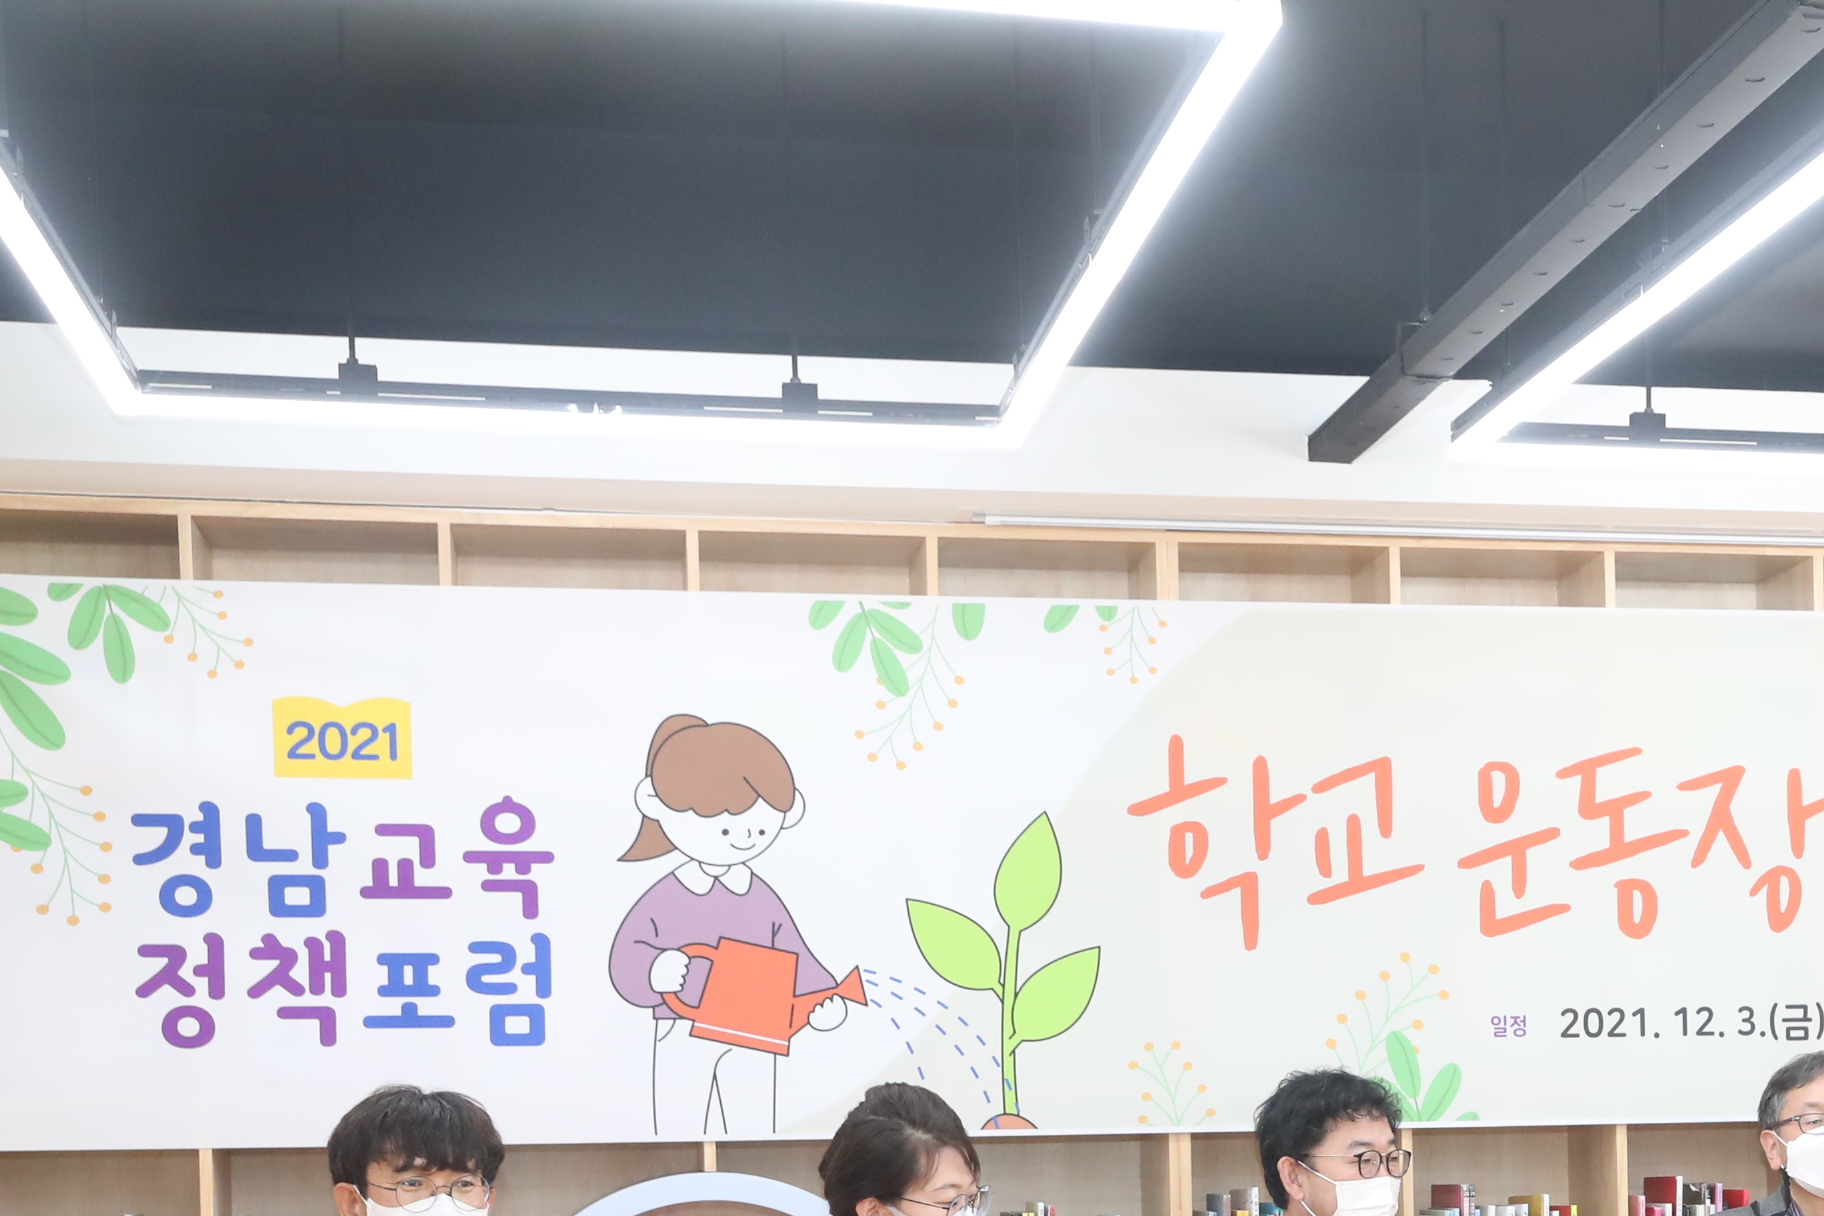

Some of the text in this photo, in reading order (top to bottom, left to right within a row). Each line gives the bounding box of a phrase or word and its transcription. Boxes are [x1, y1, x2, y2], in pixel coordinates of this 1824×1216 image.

[287, 721, 399, 762] 2021
[131, 796, 555, 919] 경남교육
[1127, 734, 1426, 952] 학교
[135, 930, 553, 1050] 정책포럼
[1490, 1014, 1529, 1040] 일정
[1559, 1006, 1662, 1041] 2021.
[1673, 1005, 1727, 1040] 12.
